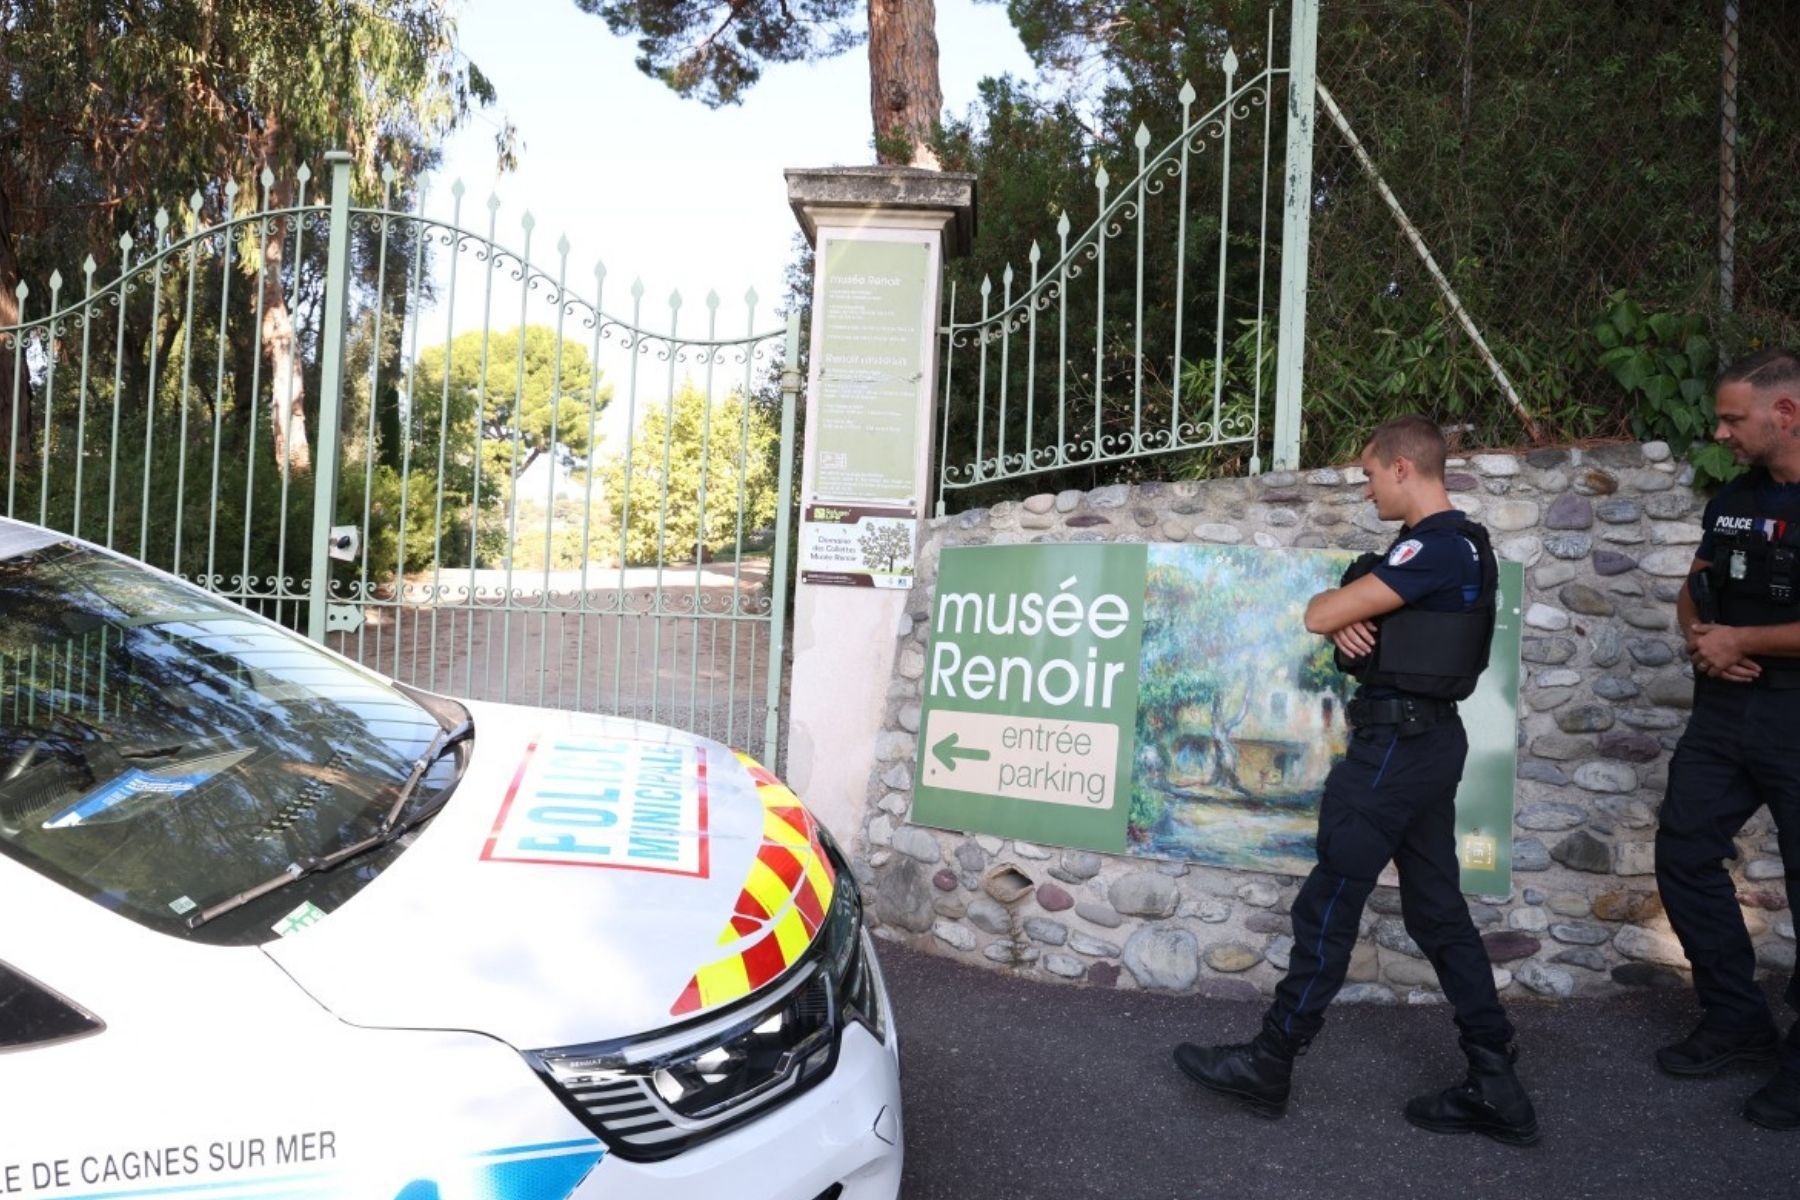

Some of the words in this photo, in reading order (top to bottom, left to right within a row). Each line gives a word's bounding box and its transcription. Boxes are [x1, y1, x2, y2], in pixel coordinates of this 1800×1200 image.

[1715, 515, 1753, 530] POLICE
[936, 575, 1130, 640] musée
[930, 641, 1125, 708] Renoir
[1002, 724, 1092, 756] entrée
[627, 744, 683, 862] MUNICIPALE
[998, 761, 1106, 804] parking
[0, 1165, 22, 1195] E
[32, 1160, 72, 1190] DE
[80, 1145, 199, 1185] CAGNES
[208, 1138, 266, 1172] SUR
[276, 1130, 337, 1165] MER
